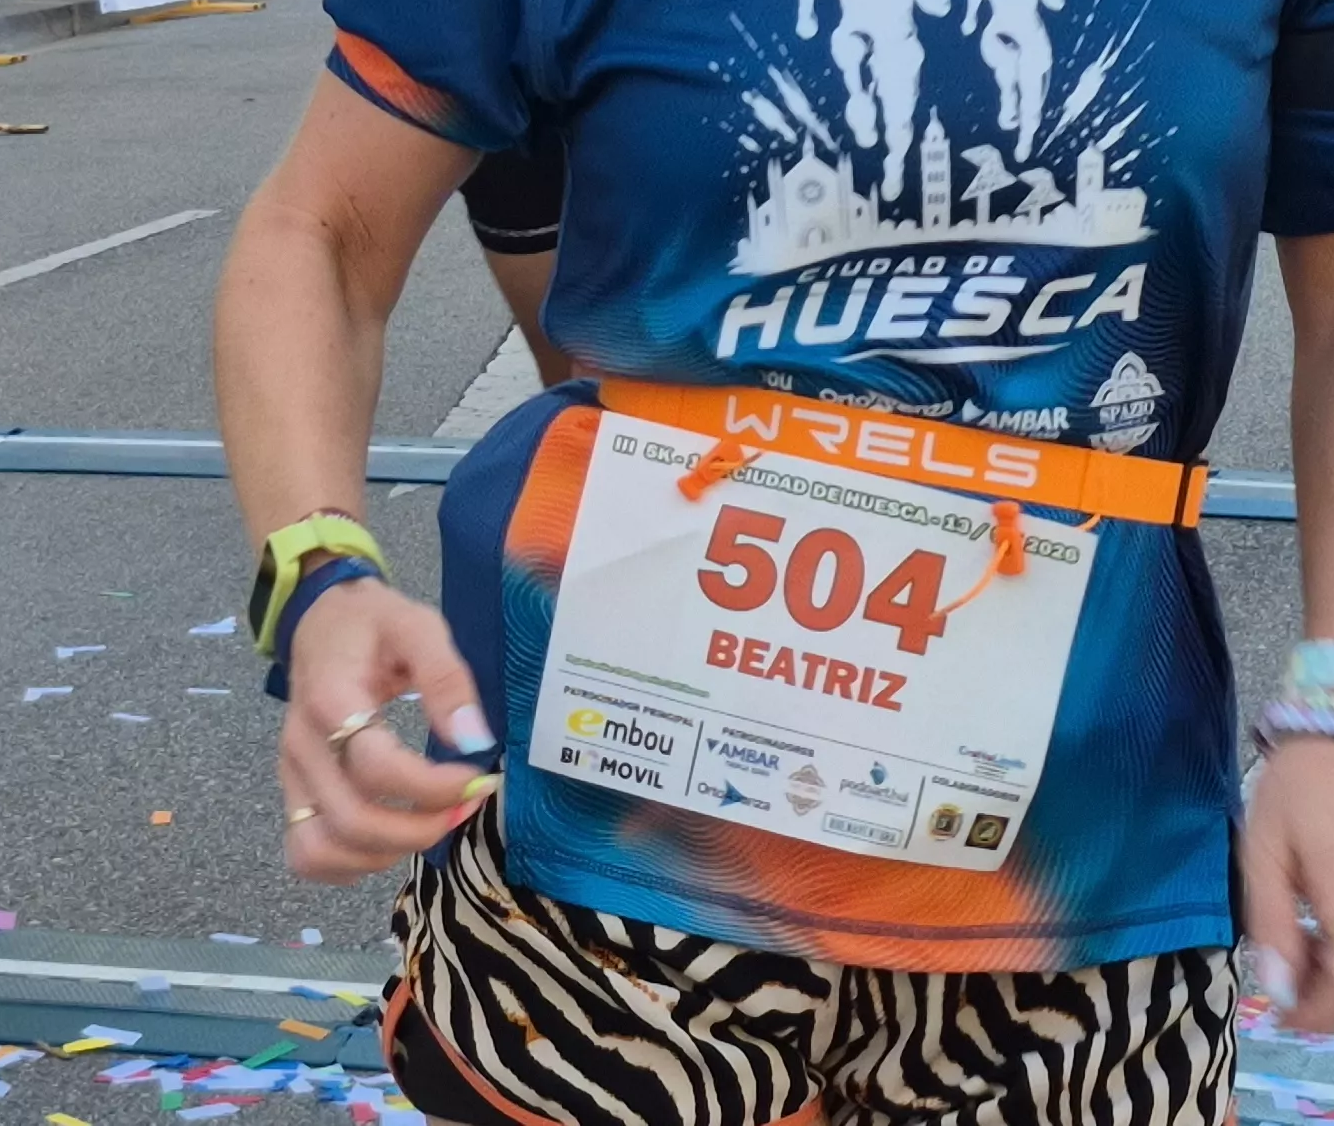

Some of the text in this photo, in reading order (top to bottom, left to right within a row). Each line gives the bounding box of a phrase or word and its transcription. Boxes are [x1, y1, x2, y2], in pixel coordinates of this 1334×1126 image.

[797, 254, 1017, 284] CIUDAD DE
[716, 263, 1148, 360] HUESCA
[726, 395, 1041, 490] WRELS
[976, 406, 1070, 432] AMBAR
[732, 466, 808, 496] CIUDAD
[810, 482, 842, 504] DE
[843, 489, 929, 525] HUESCA
[697, 503, 948, 656] 504
[706, 629, 908, 712] BEATRIZ
[567, 708, 675, 756] embou
[719, 742, 780, 771] AMBAR
